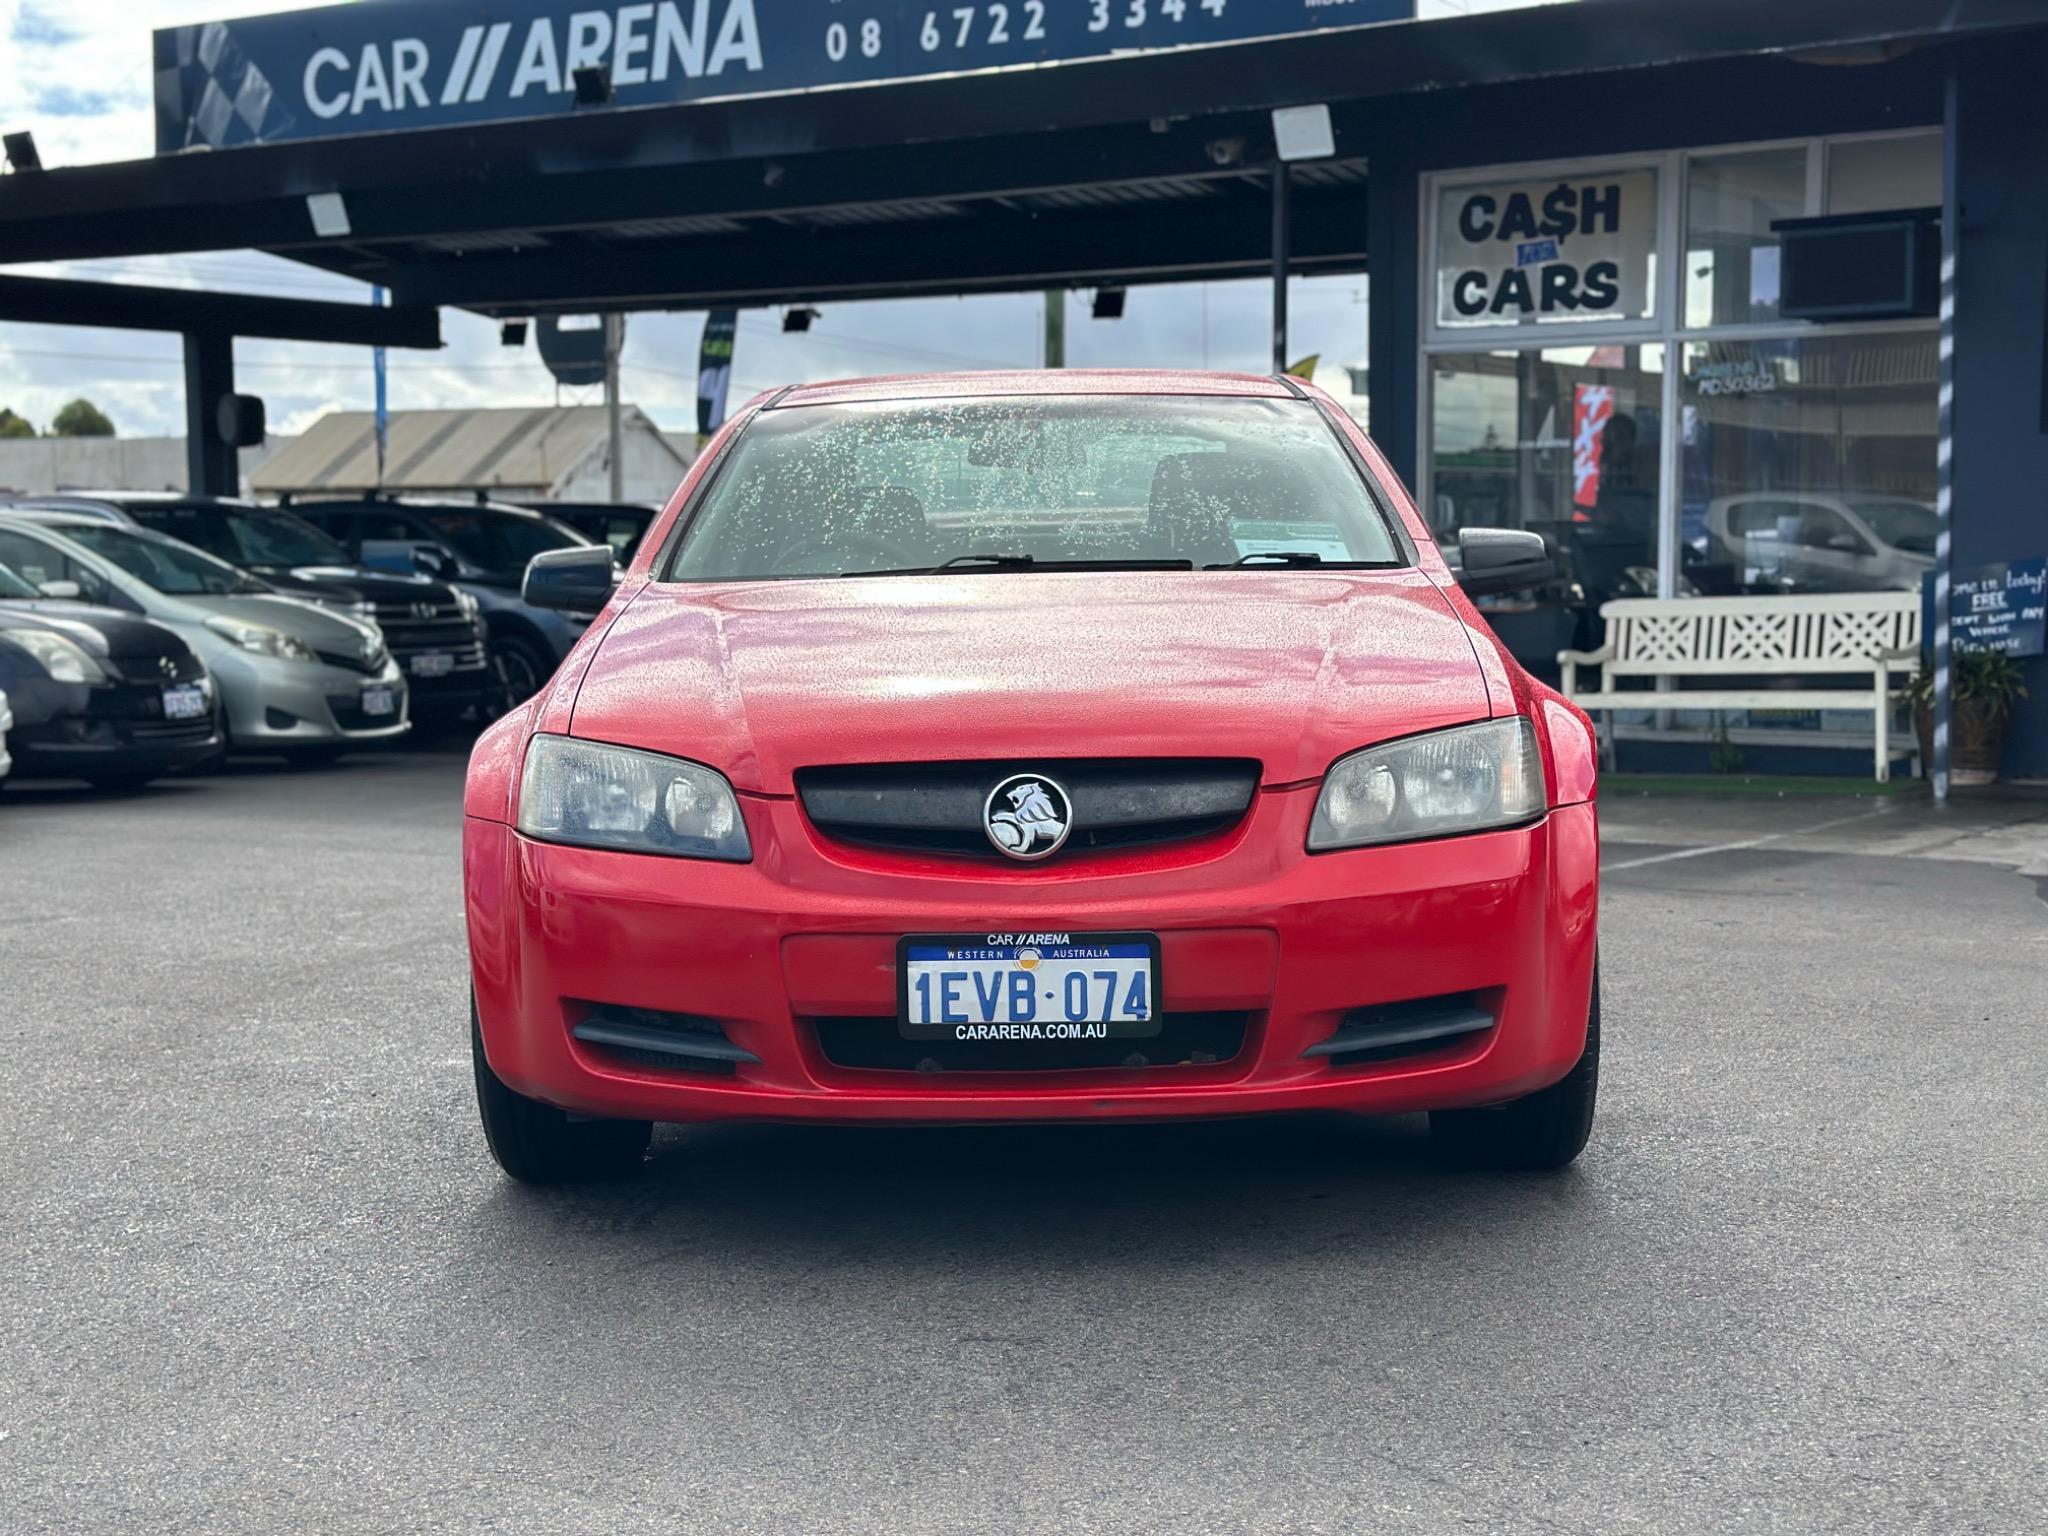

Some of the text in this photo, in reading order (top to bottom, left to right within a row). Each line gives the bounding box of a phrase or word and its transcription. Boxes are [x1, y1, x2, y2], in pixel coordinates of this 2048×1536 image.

[825, 18, 882, 62] 08
[918, 0, 1046, 52] 6722
[303, 38, 430, 120] CAR
[509, 0, 763, 98] ARENA
[1453, 260, 1619, 316] CARS
[947, 948, 1111, 960] WESTERN AUSTRALIA
[987, 934, 1014, 946] CAR
[1026, 933, 1071, 946] ARENA
[955, 1023, 1108, 1040] CARARENA.COM.AU
